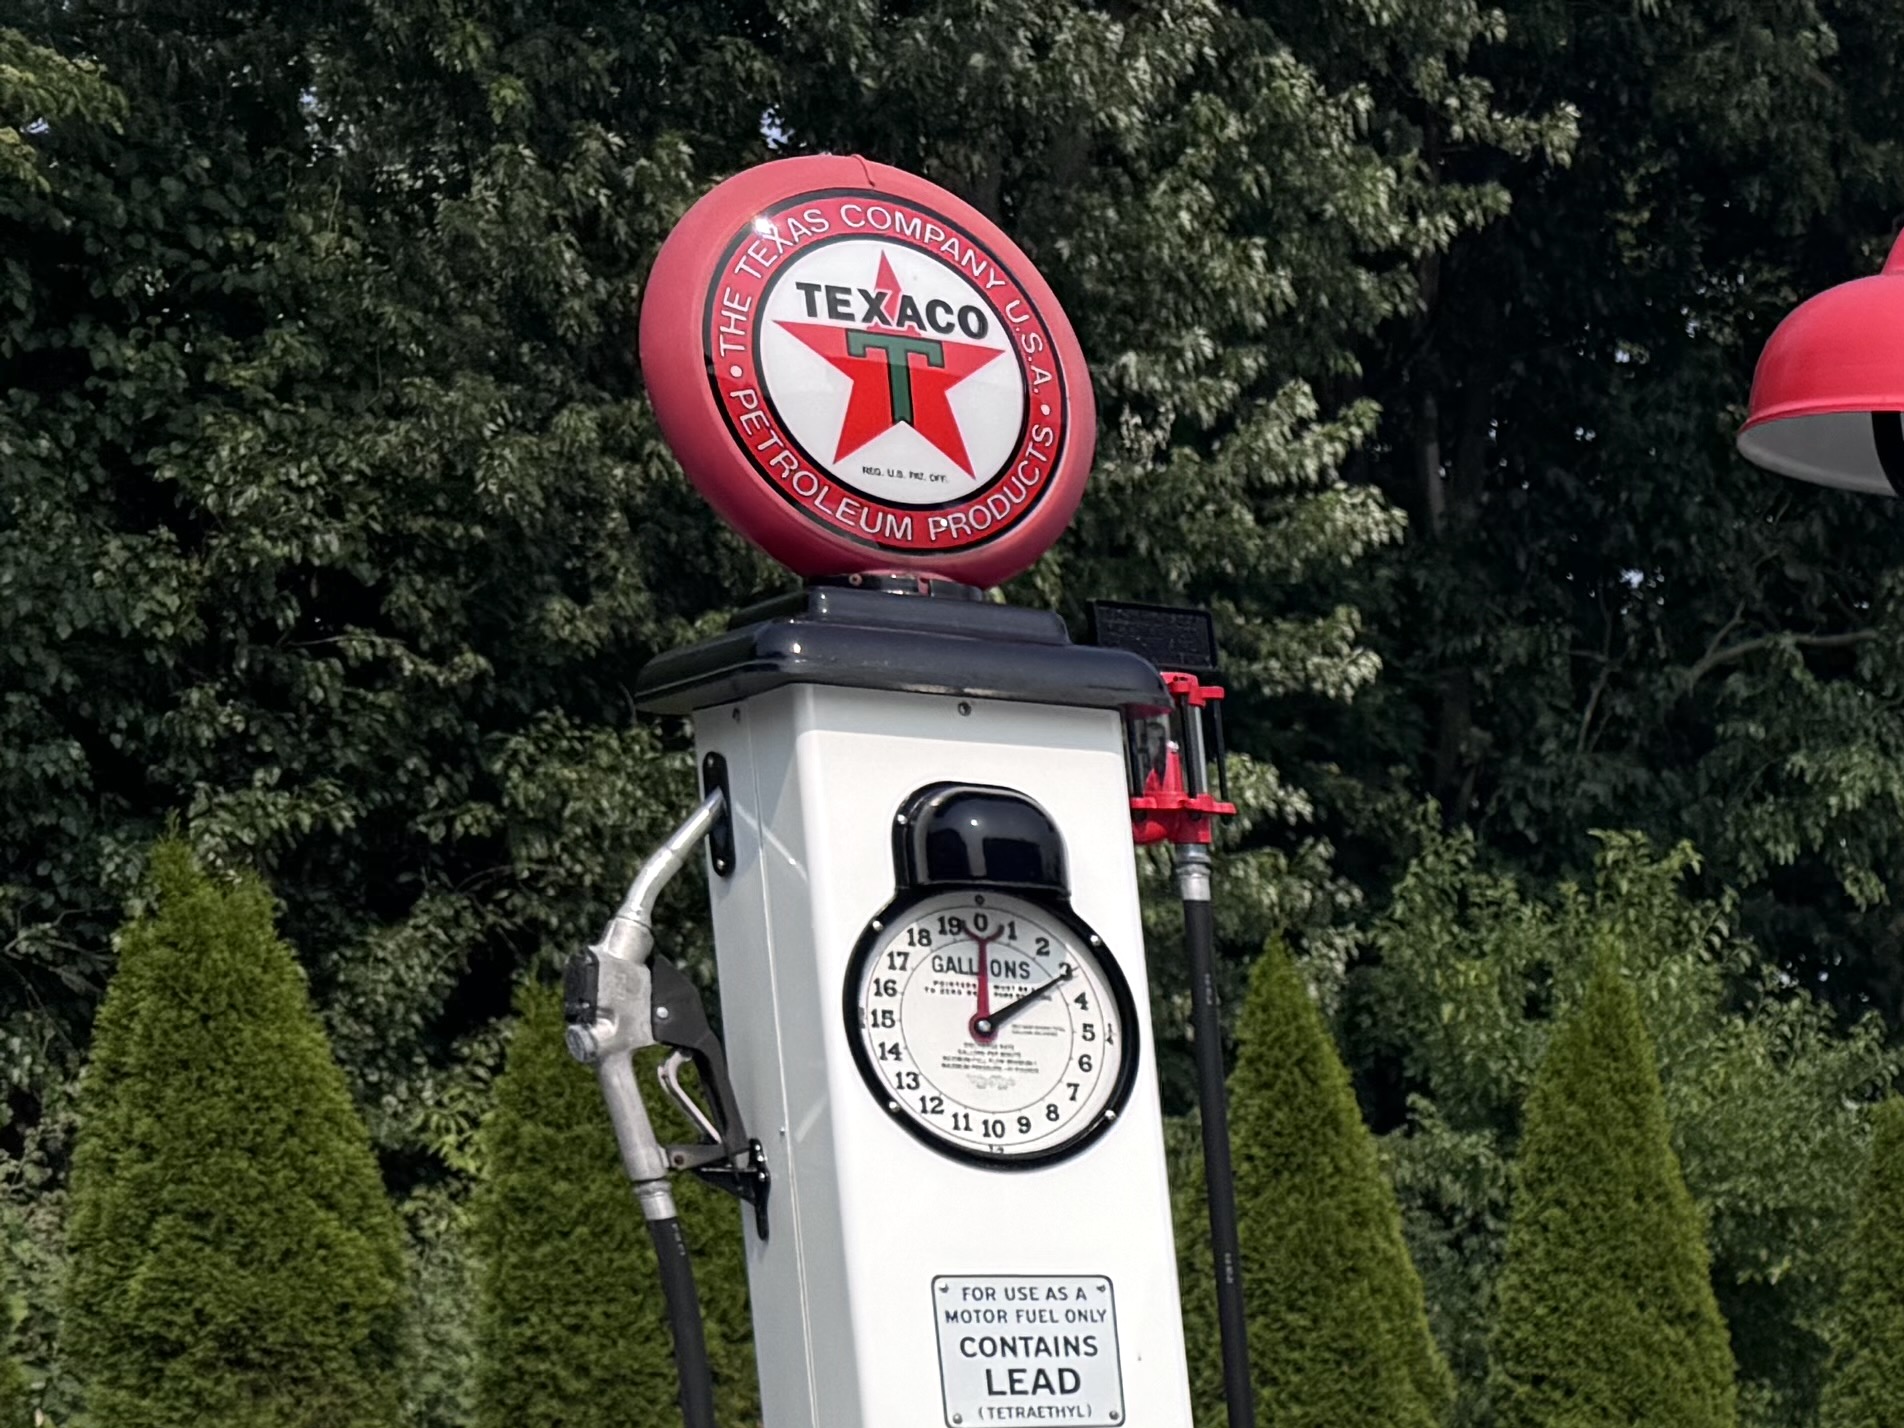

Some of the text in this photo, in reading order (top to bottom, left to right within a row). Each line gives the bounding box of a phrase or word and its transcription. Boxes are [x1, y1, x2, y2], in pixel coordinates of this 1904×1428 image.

[719, 203, 1053, 394] THE TEXAS COMPANY U.S.A.
[795, 281, 988, 340] TEXACO
[845, 328, 944, 427] T
[729, 387, 1055, 542] PETROLEUM PRODUCTS
[937, 915, 962, 936] 19
[973, 912, 988, 932] 0
[1007, 920, 1018, 941] 1
[906, 927, 932, 948] 18
[1035, 936, 1050, 957] 2
[886, 952, 910, 973] 17
[931, 954, 1031, 979] GALLONS
[873, 977, 898, 998] 16
[1074, 992, 1089, 1012] 4
[871, 1008, 896, 1028] 15
[1081, 1022, 1096, 1042] 5
[878, 1039, 904, 1062] 14
[1078, 1053, 1093, 1073] 6
[896, 1071, 921, 1092] 13
[1067, 1082, 1081, 1103] 7
[919, 1095, 945, 1116] 12
[1045, 1102, 1061, 1122] 8
[952, 1111, 973, 1132] 11
[982, 1118, 1006, 1139] 10
[1017, 1115, 1033, 1135] 9
[962, 1286, 1087, 1301] FOR USE AS A
[944, 1309, 1107, 1324] MOTOR FUEL ONLY
[959, 1335, 1098, 1358] CONTAINS
[985, 1367, 1081, 1396] LEAD
[978, 1403, 1092, 1420] (TETRAETHYL)
